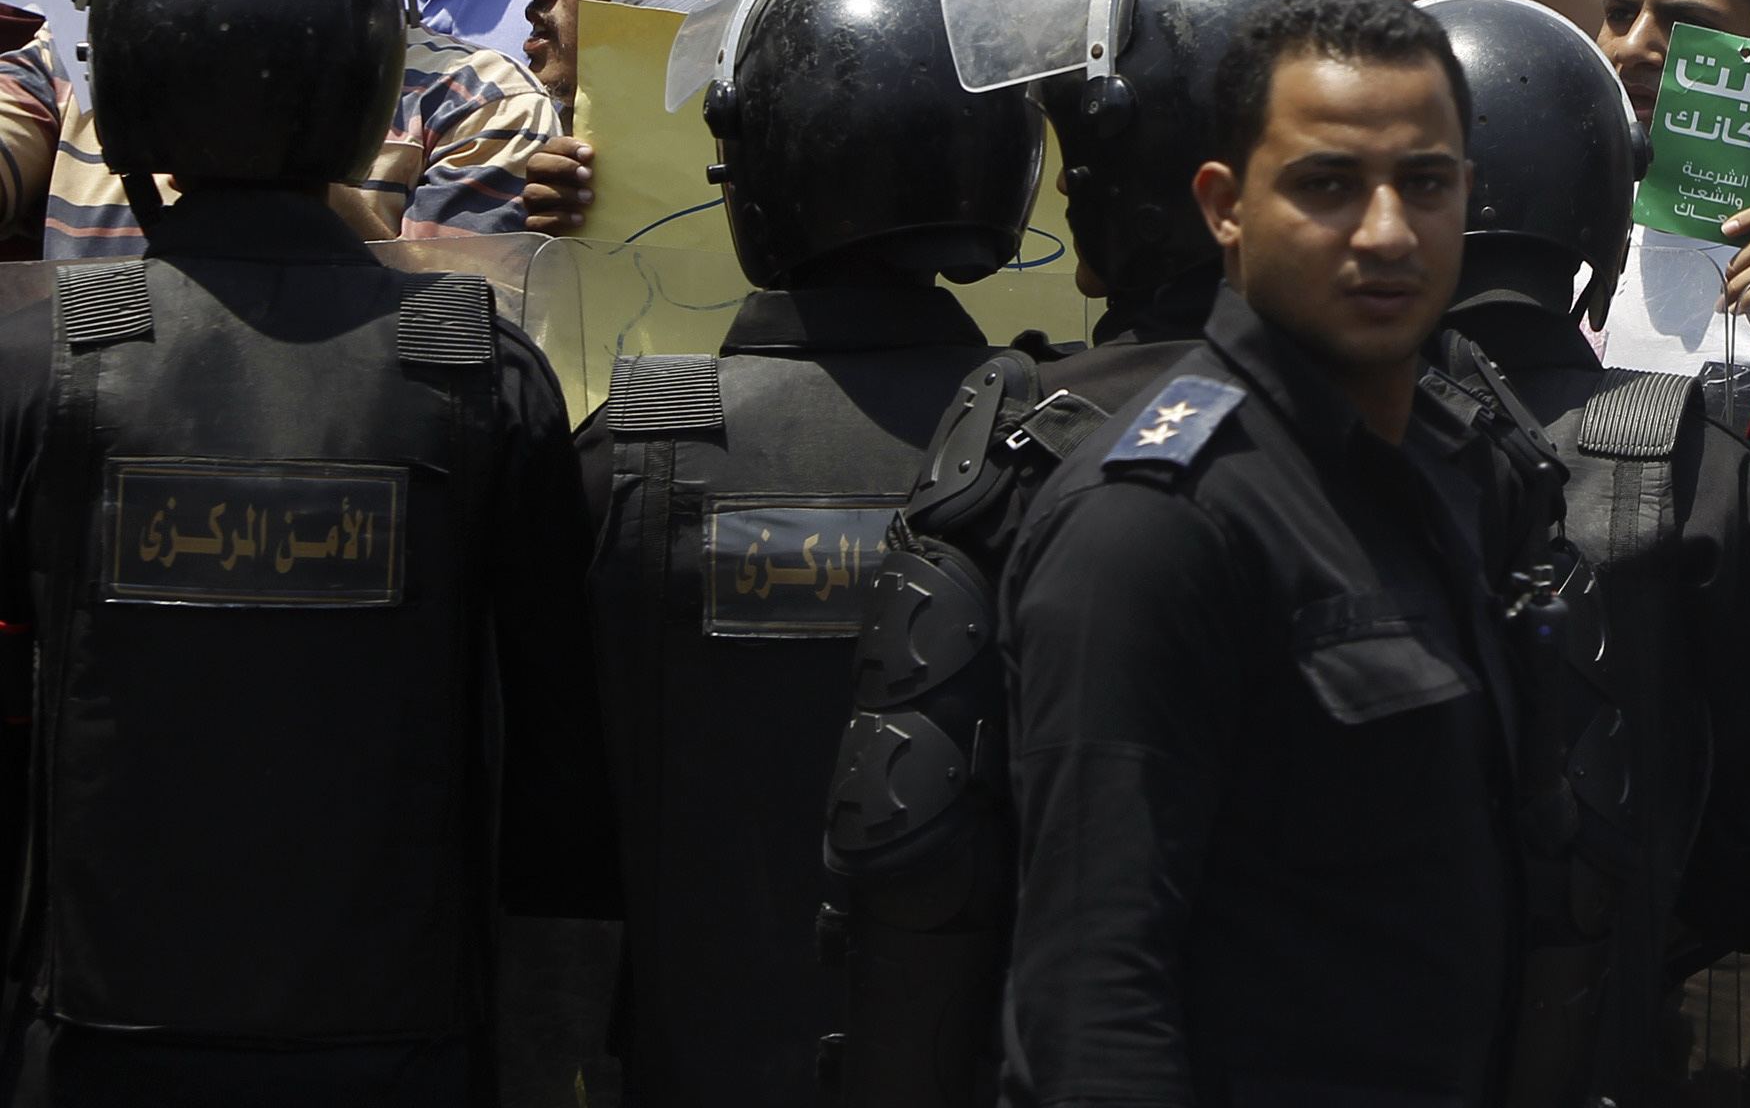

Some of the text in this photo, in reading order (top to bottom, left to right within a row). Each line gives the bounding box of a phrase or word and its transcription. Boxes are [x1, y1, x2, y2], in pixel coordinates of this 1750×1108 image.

[1682, 160, 1749, 189] الشرعية
[1678, 184, 1744, 210] والشعب
[1674, 202, 1728, 224] عاك
[275, 495, 374, 574] الأمن
